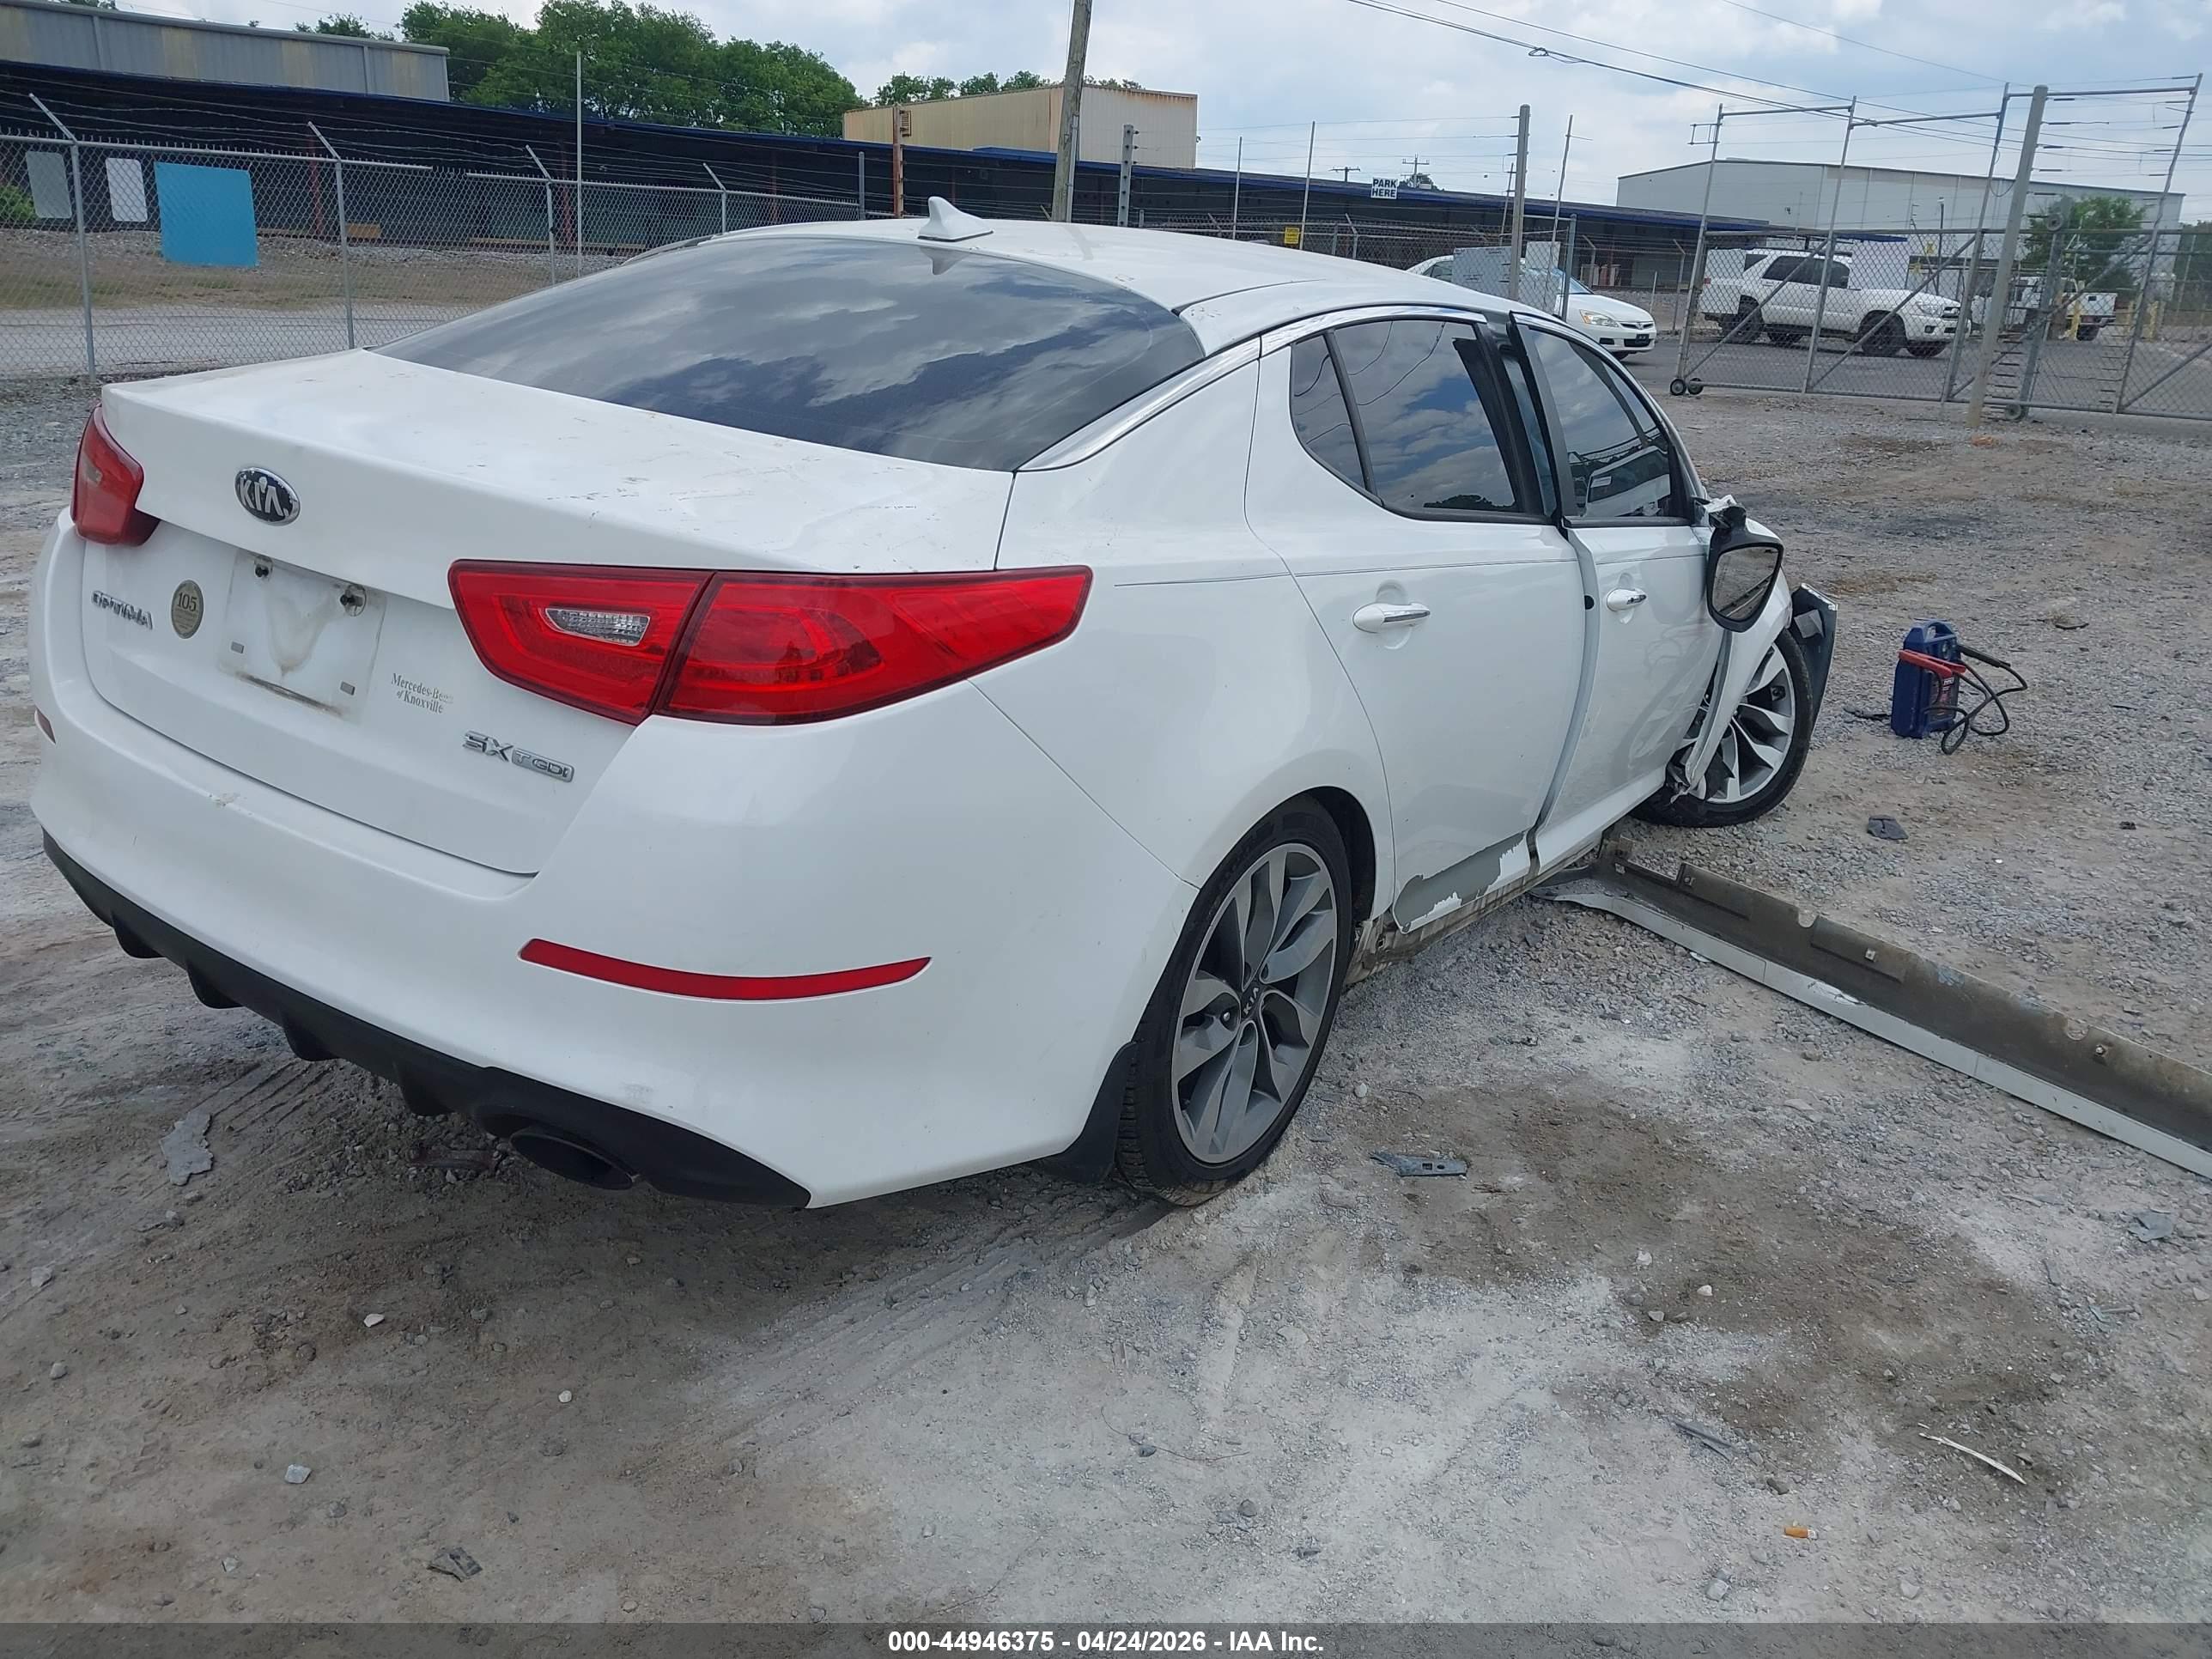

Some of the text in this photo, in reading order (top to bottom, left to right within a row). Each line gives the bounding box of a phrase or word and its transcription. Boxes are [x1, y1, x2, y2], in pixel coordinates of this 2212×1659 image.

[1372, 188, 1396, 198] HERE
[1373, 178, 1397, 188] PARK
[240, 473, 284, 517] KIA
[91, 591, 154, 630] OPTIMA
[177, 592, 198, 612] 105
[397, 690, 444, 714] of Knoxville
[1243, 988, 1260, 1015] KIA
